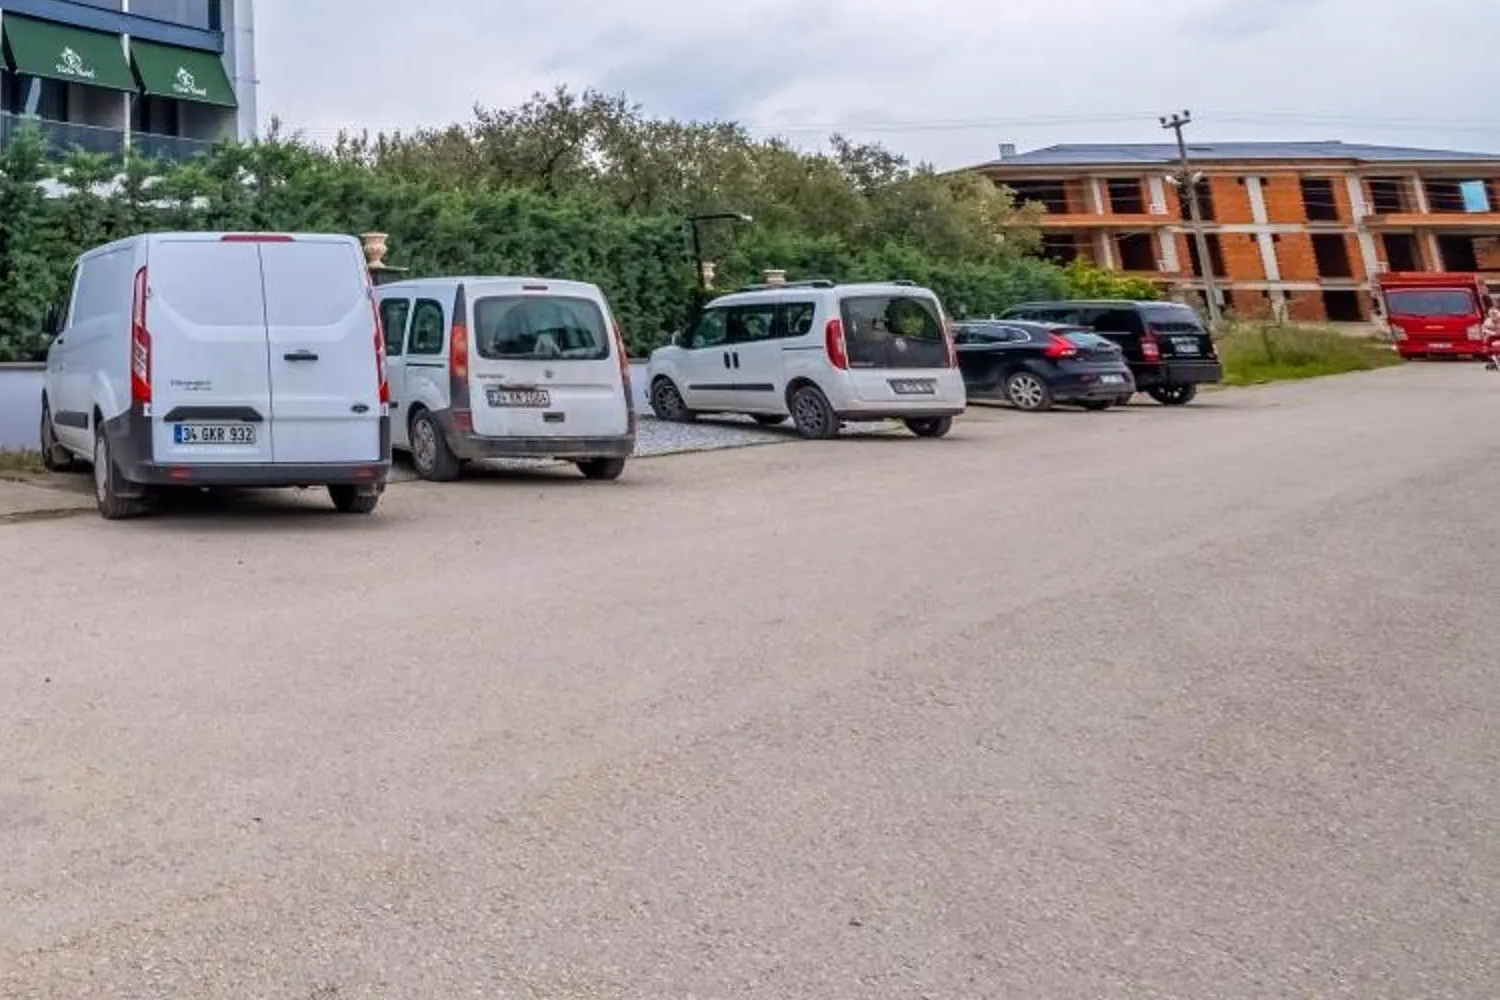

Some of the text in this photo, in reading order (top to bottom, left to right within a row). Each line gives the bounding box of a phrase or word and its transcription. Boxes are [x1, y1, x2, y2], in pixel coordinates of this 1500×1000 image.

[183, 427, 253, 441] 34 GKR 932
